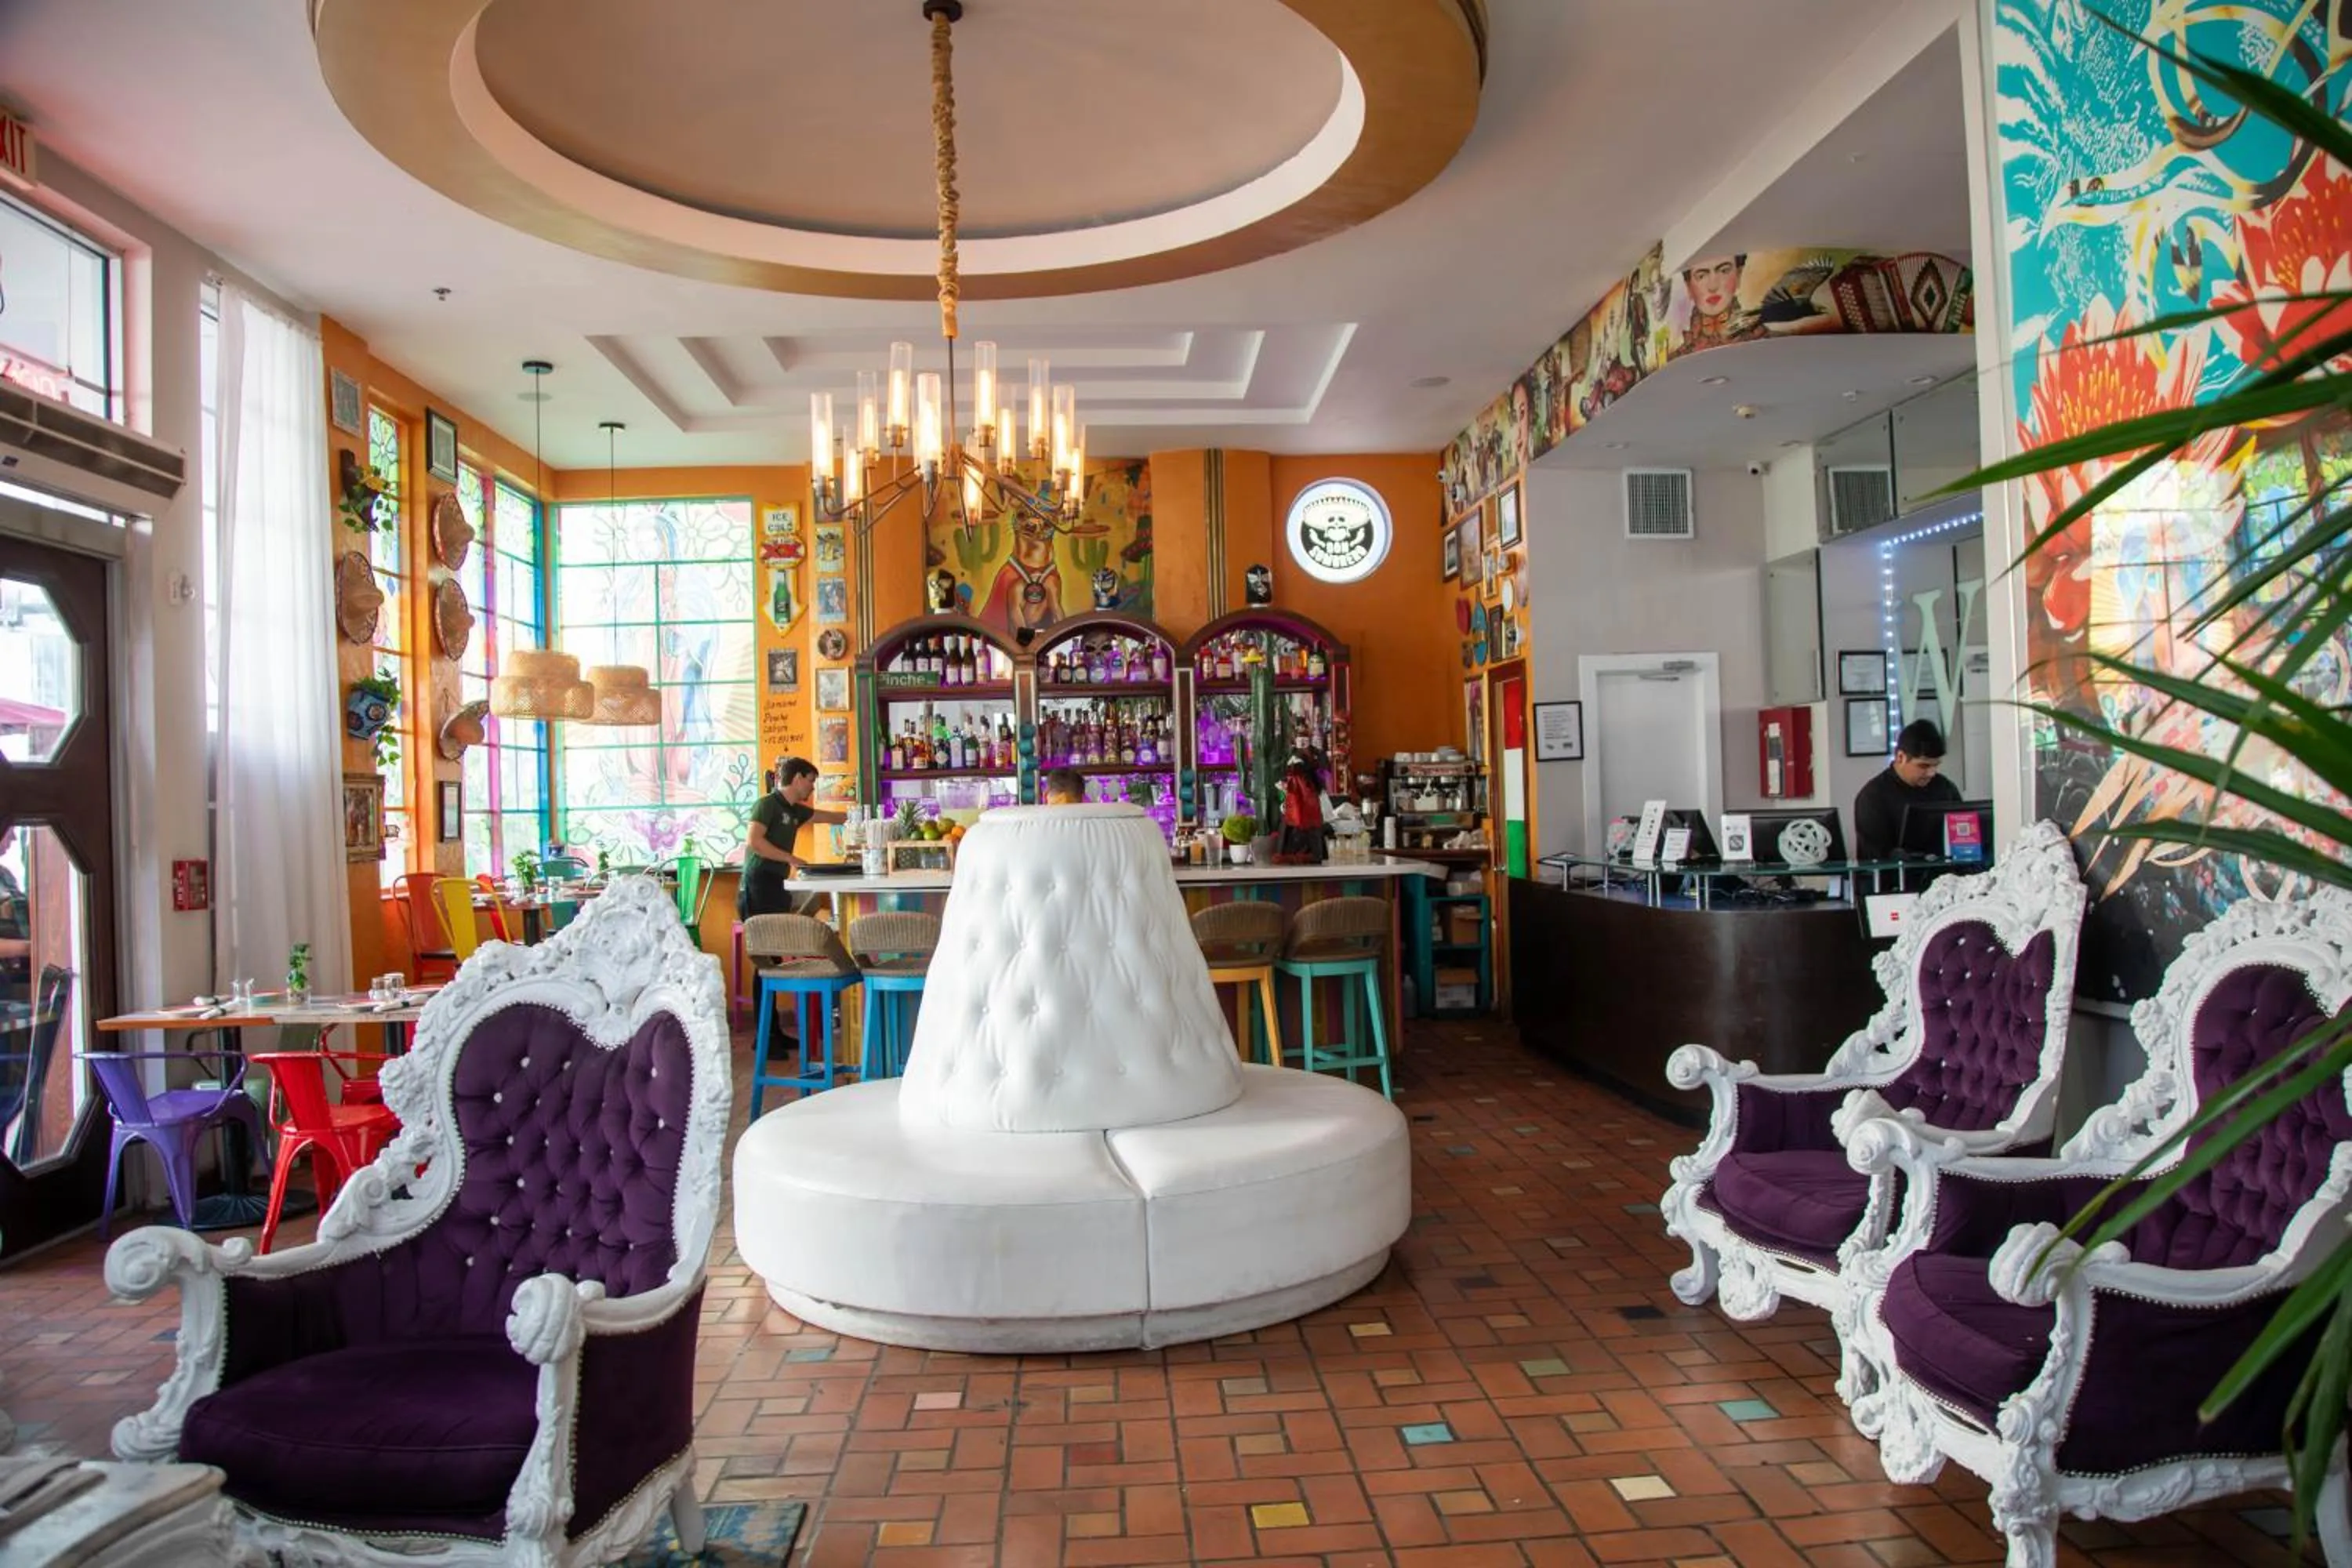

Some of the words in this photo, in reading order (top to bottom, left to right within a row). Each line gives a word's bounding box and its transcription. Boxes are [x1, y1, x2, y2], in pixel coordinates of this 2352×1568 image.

[0, 114, 26, 174] XIT
[772, 513, 788, 522] ICE
[879, 673, 925, 687] Pinche
